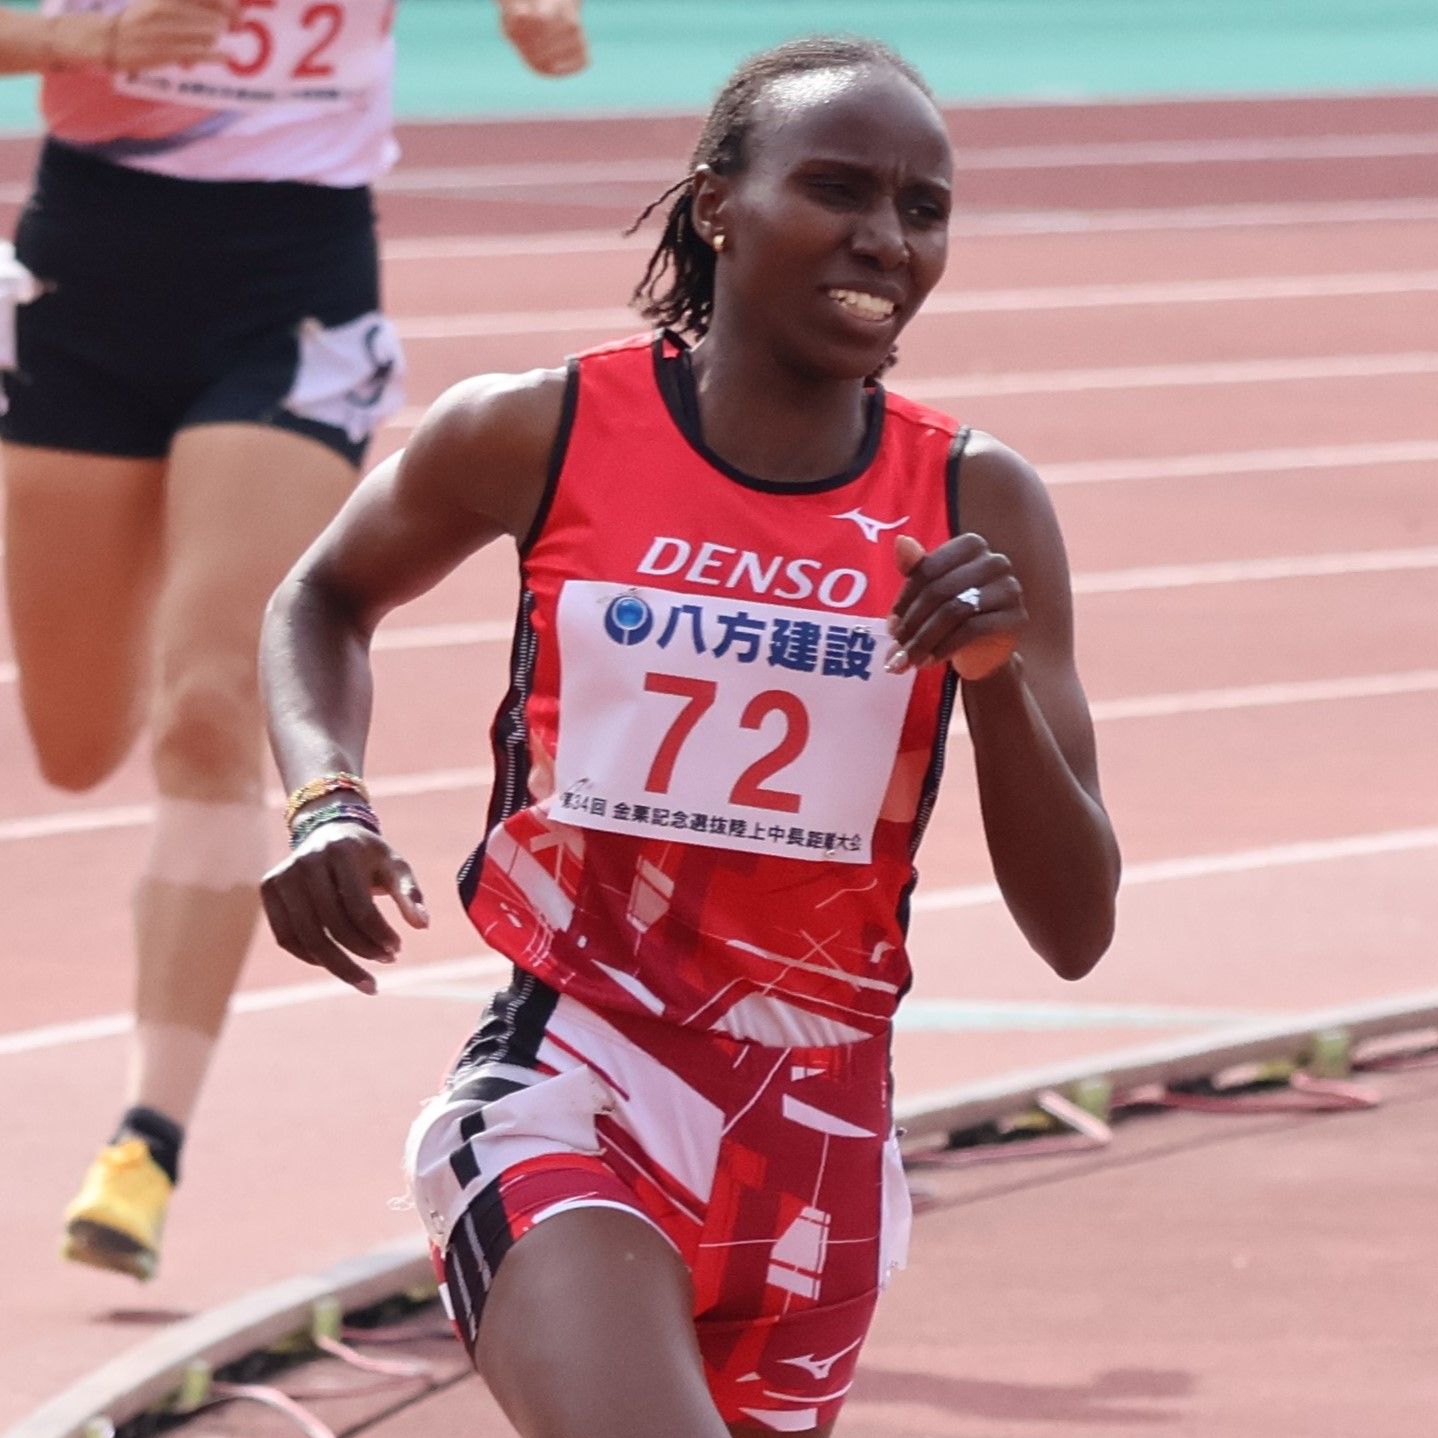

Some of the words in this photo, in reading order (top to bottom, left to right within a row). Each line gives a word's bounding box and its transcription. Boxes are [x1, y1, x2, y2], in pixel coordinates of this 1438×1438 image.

[636, 536, 869, 609] DENSO
[656, 604, 876, 681] 八方建設
[643, 672, 811, 814] 72
